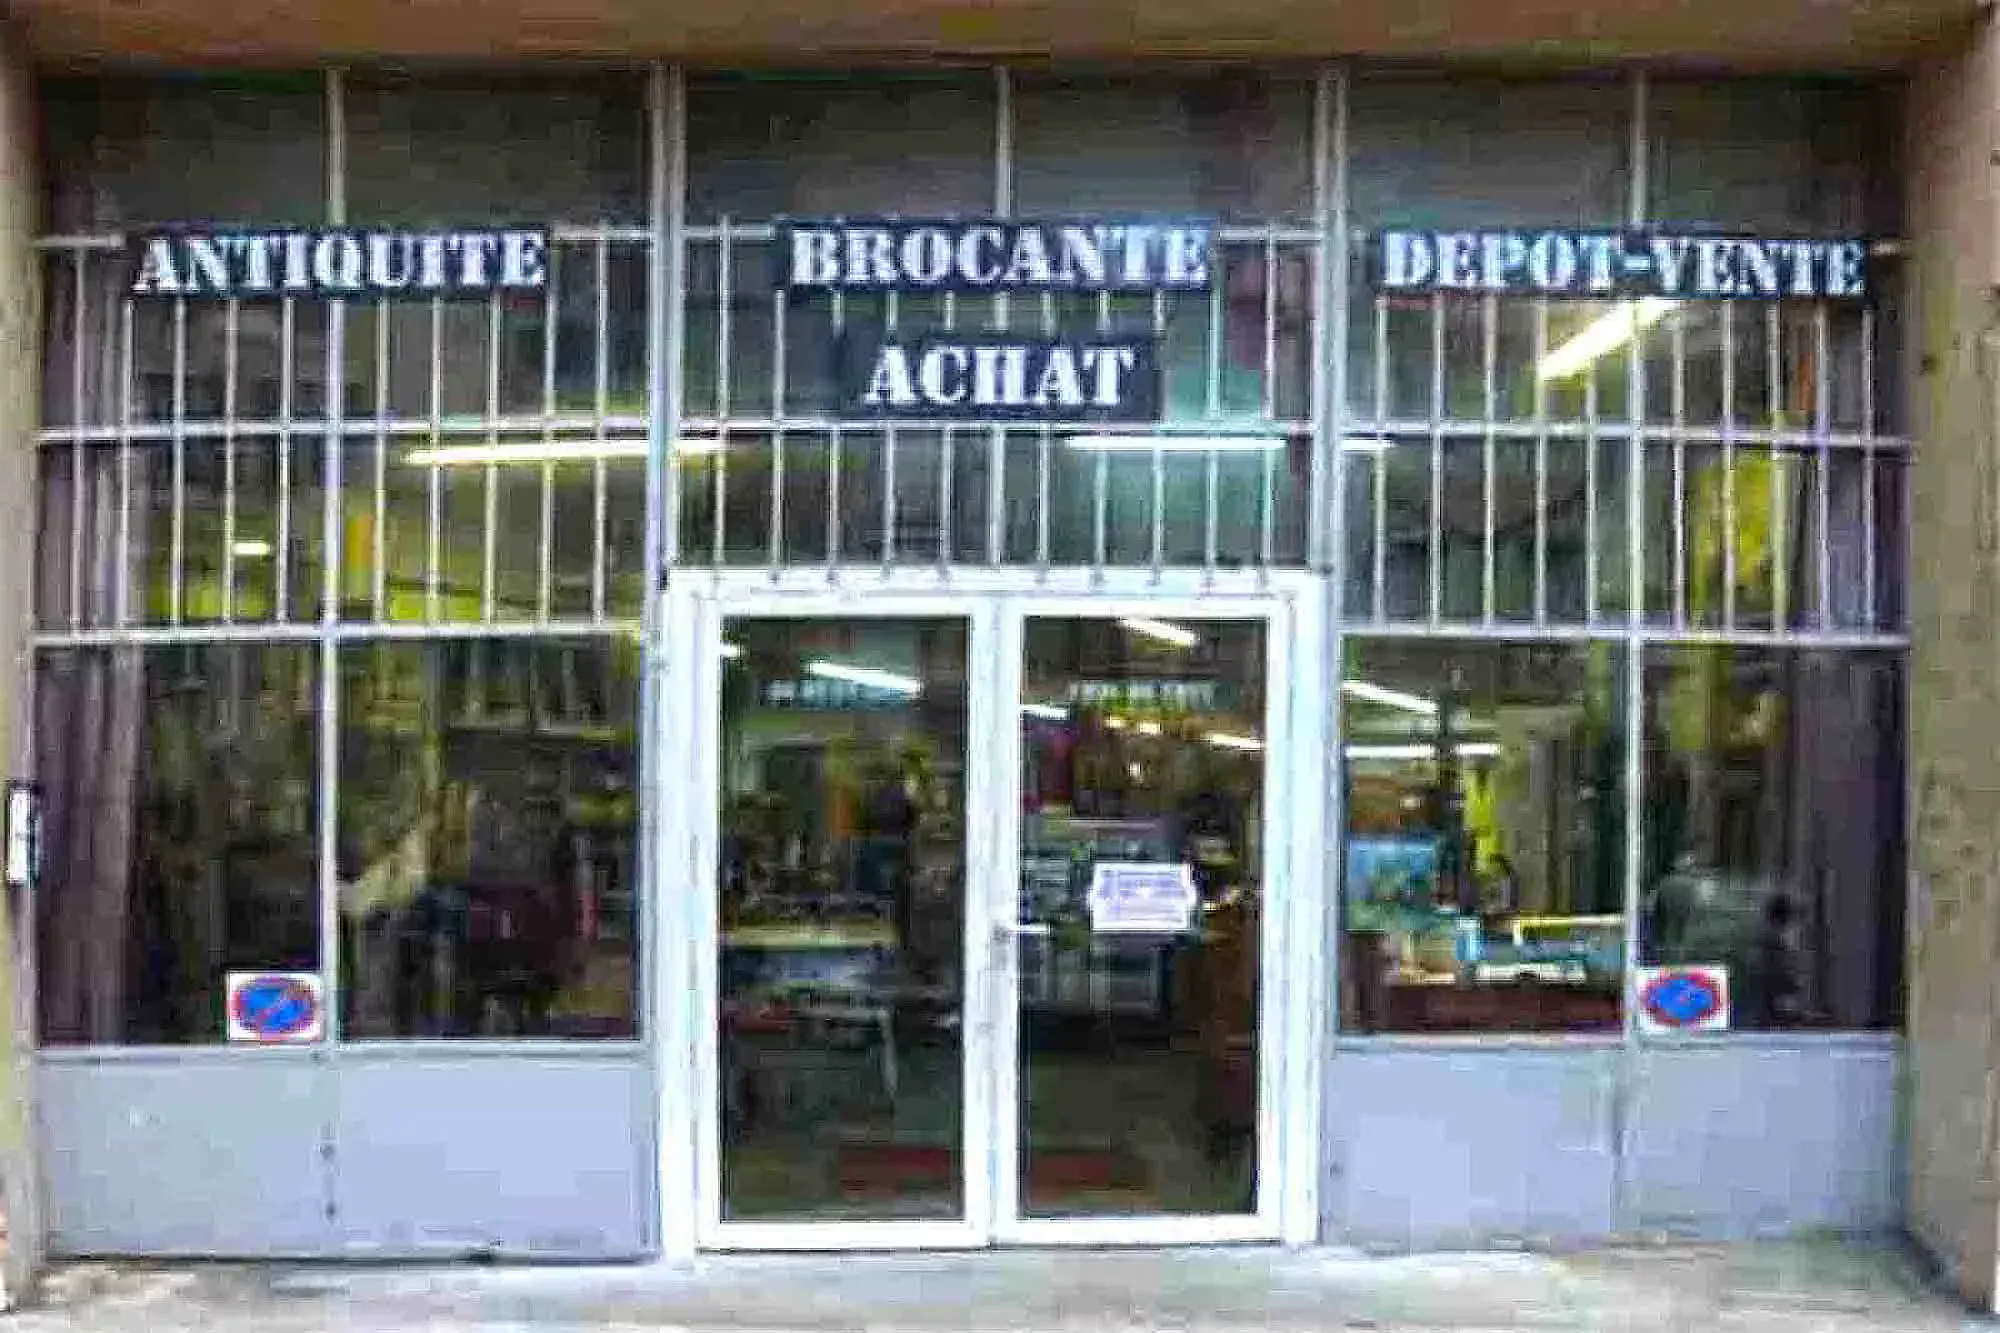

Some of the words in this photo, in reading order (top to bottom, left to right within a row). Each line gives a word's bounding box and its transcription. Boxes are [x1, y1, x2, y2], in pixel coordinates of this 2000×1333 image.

[132, 230, 545, 292] ANTIQUITE
[791, 226, 1209, 284] BROCANTE
[1383, 230, 1866, 294] DEPOT-VENTE
[864, 346, 1136, 406] ACHAT
